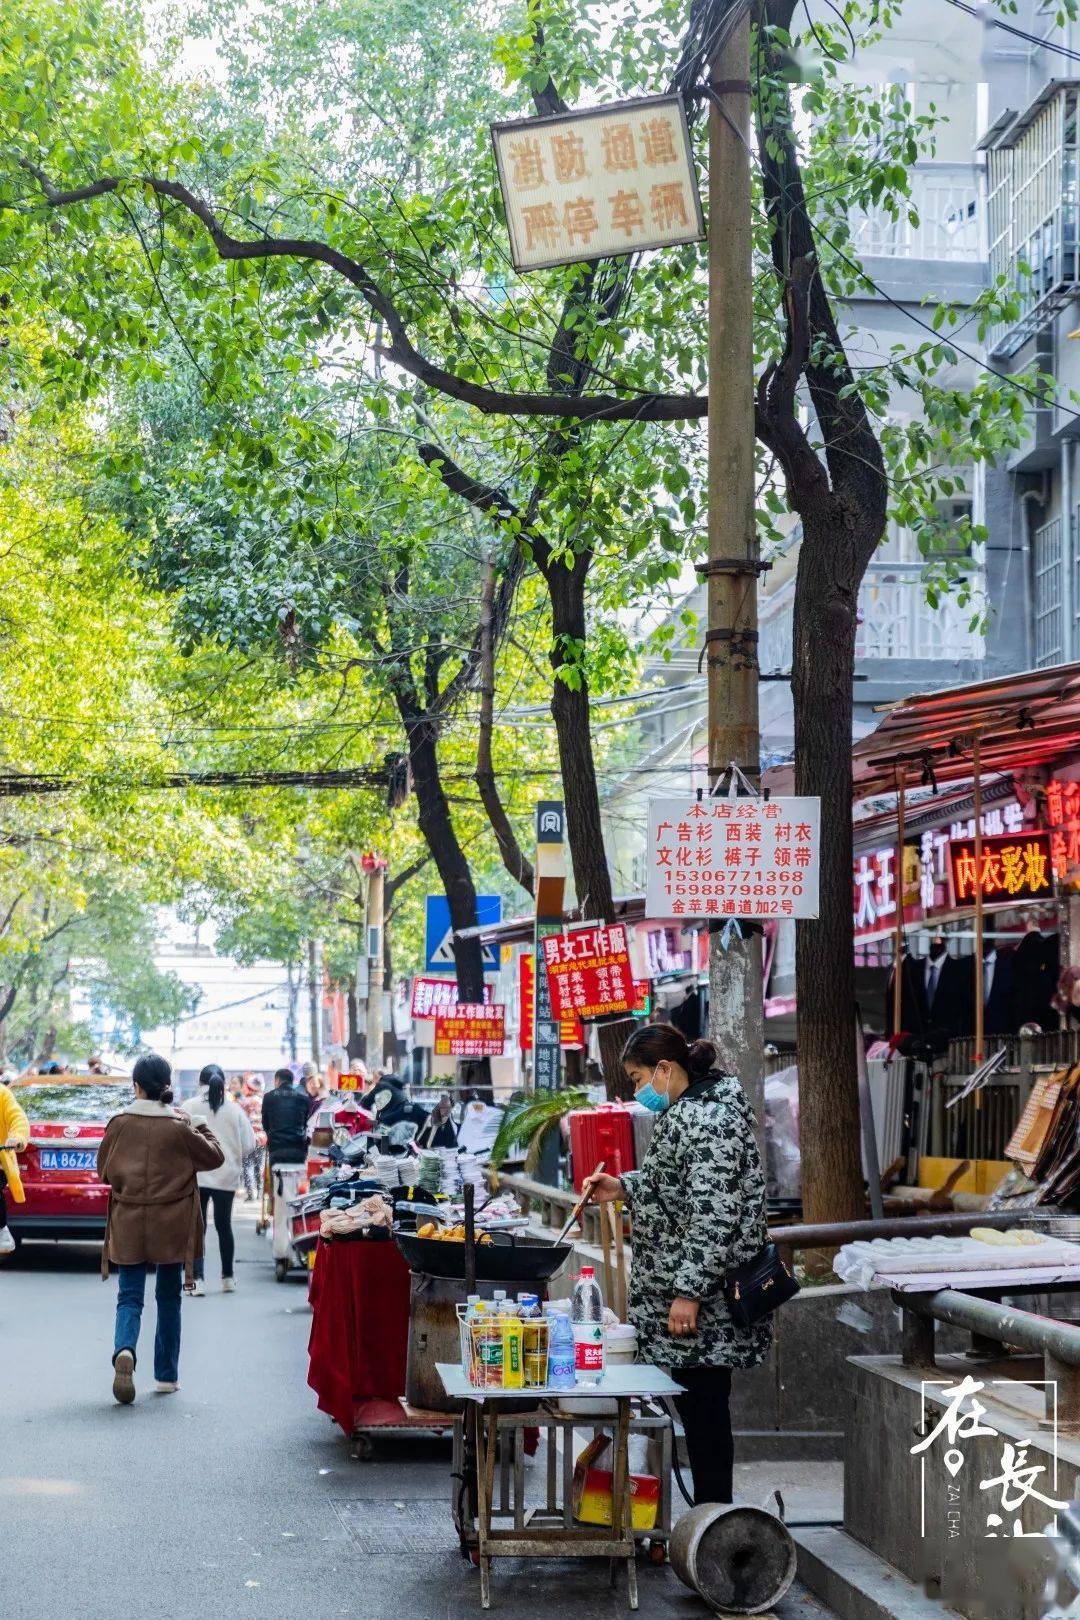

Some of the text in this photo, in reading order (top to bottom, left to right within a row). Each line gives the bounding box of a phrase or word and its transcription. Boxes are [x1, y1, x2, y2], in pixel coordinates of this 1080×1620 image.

[686, 803, 783, 819] 本店经营
[656, 822, 812, 842] 广告衫 西装 衬衣
[656, 846, 812, 867] 文化衫 裤子 领带
[664, 870, 804, 882] 15306771368
[956, 842, 1049, 898] 内衣彩妆
[663, 884, 803, 896] 15988798870
[671, 899, 795, 914] 金苹果通道加2号
[544, 927, 627, 966] 男女工作服
